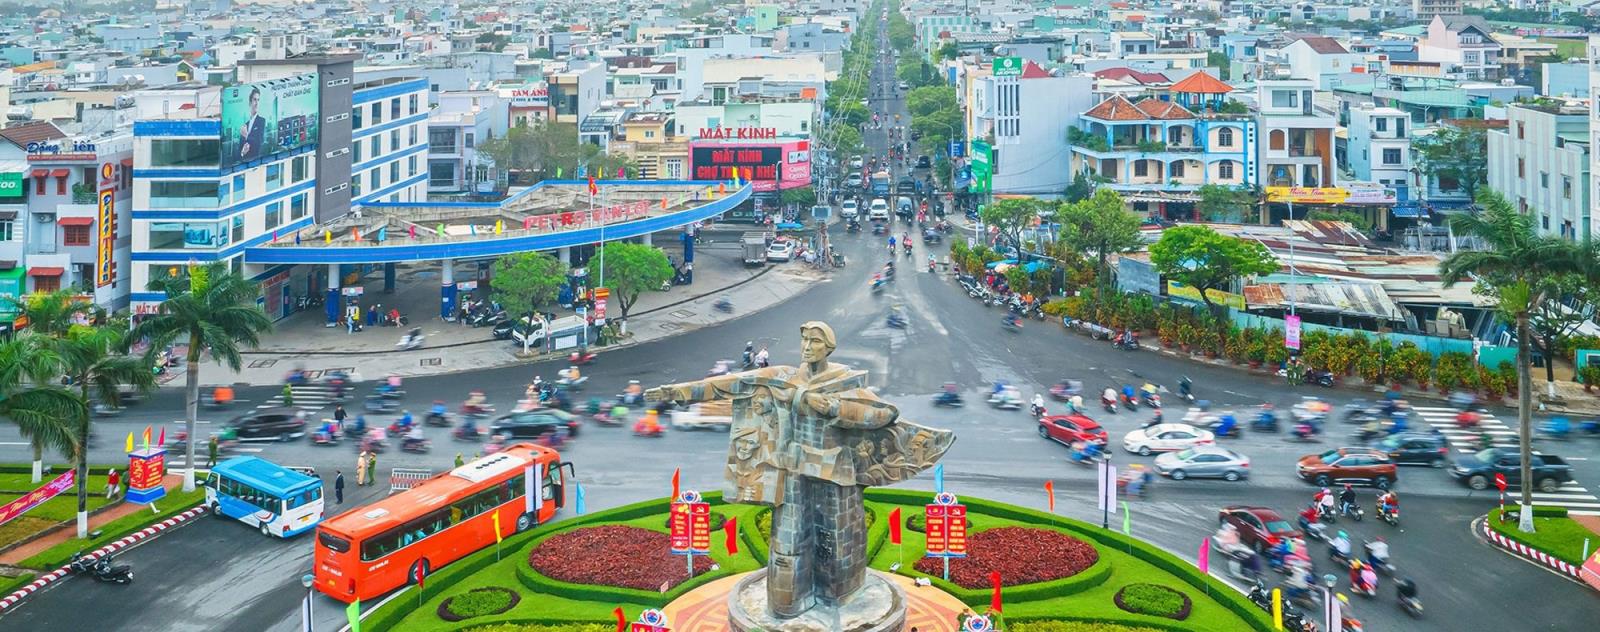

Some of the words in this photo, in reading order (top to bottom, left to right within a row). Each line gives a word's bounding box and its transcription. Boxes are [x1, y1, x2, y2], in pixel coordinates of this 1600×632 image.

[699, 123, 733, 139] MẮT
[737, 125, 776, 139] KÍNH
[27, 140, 60, 155] Đồng
[523, 210, 587, 230] PETRO
